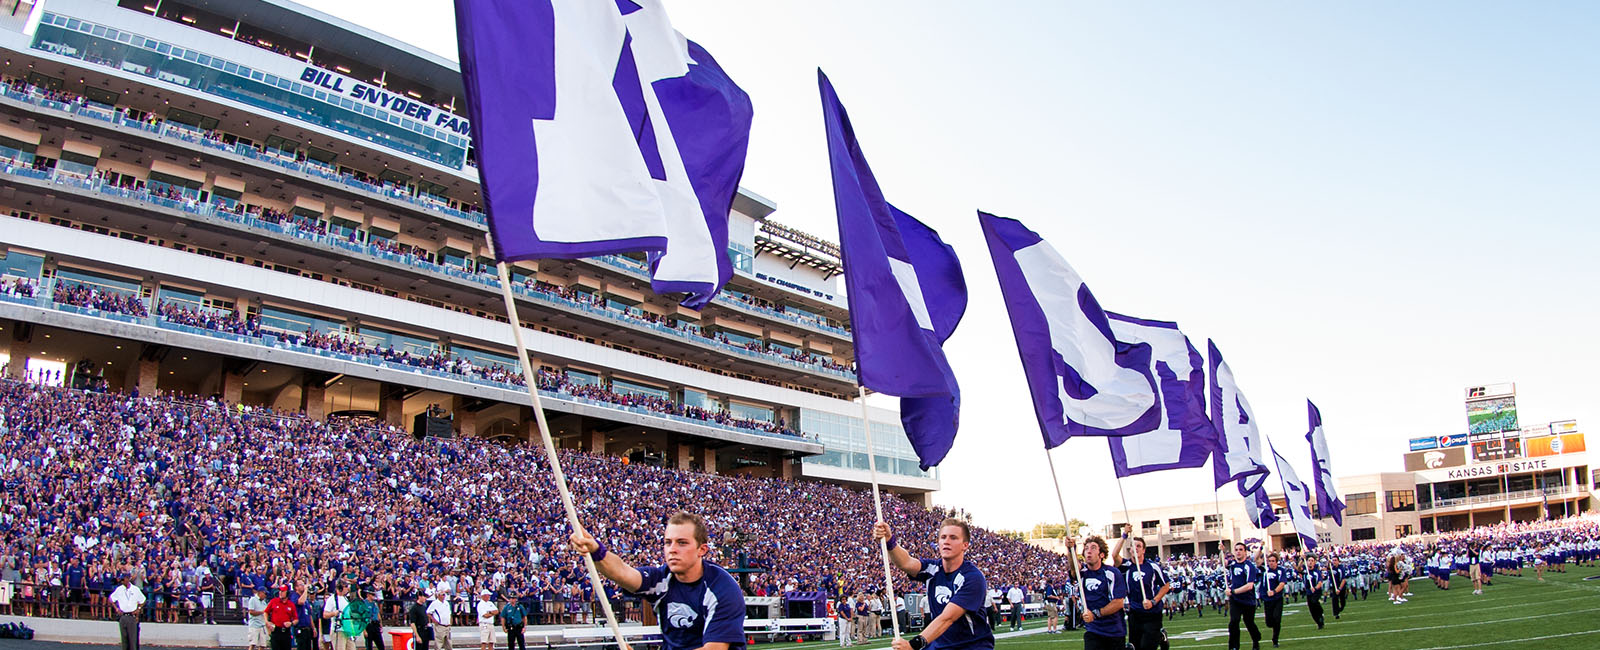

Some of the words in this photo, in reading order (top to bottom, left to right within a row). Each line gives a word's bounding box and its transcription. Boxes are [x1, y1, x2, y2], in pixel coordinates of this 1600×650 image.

[300, 66, 344, 93] BILL
[350, 83, 432, 122] SNYDER
[755, 272, 768, 281] BIG
[1448, 465, 1493, 479] KANSAS
[1513, 459, 1548, 472] STATE
